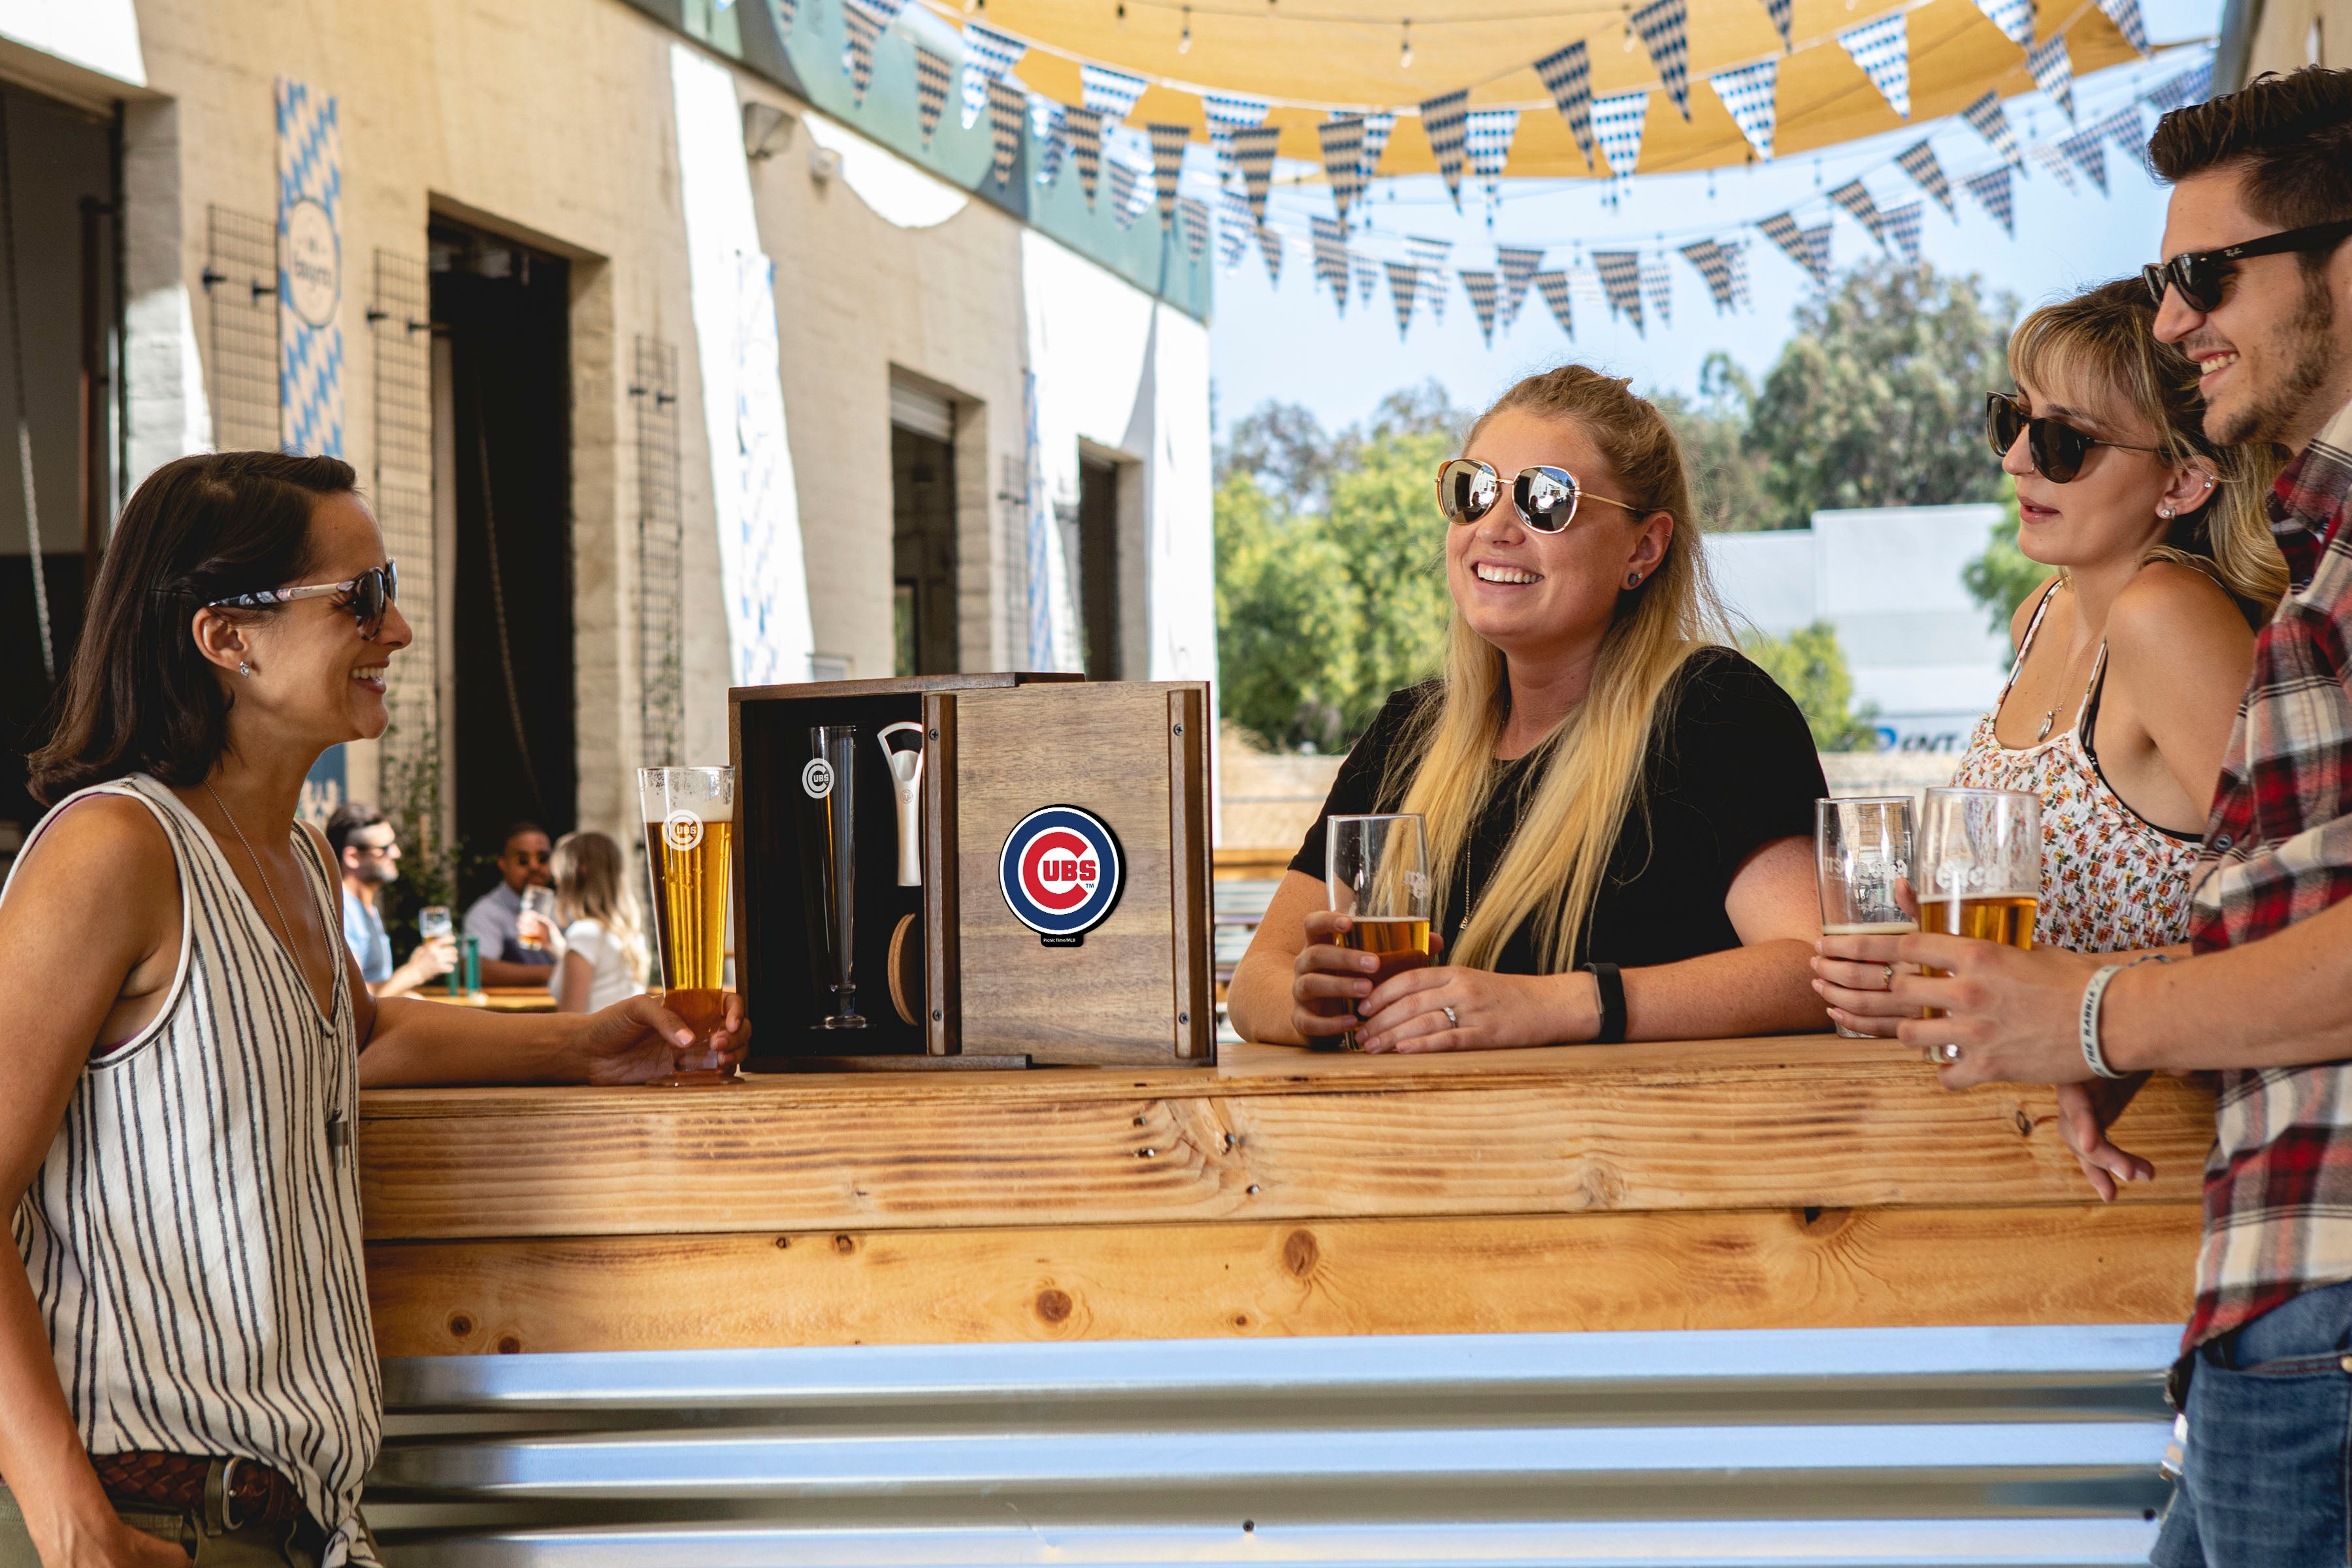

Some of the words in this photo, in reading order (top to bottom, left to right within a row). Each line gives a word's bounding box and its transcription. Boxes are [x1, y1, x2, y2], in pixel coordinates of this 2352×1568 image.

[808, 764, 829, 792] CUBS
[669, 816, 697, 844] CUBS
[1022, 832, 1096, 910] CUBS
